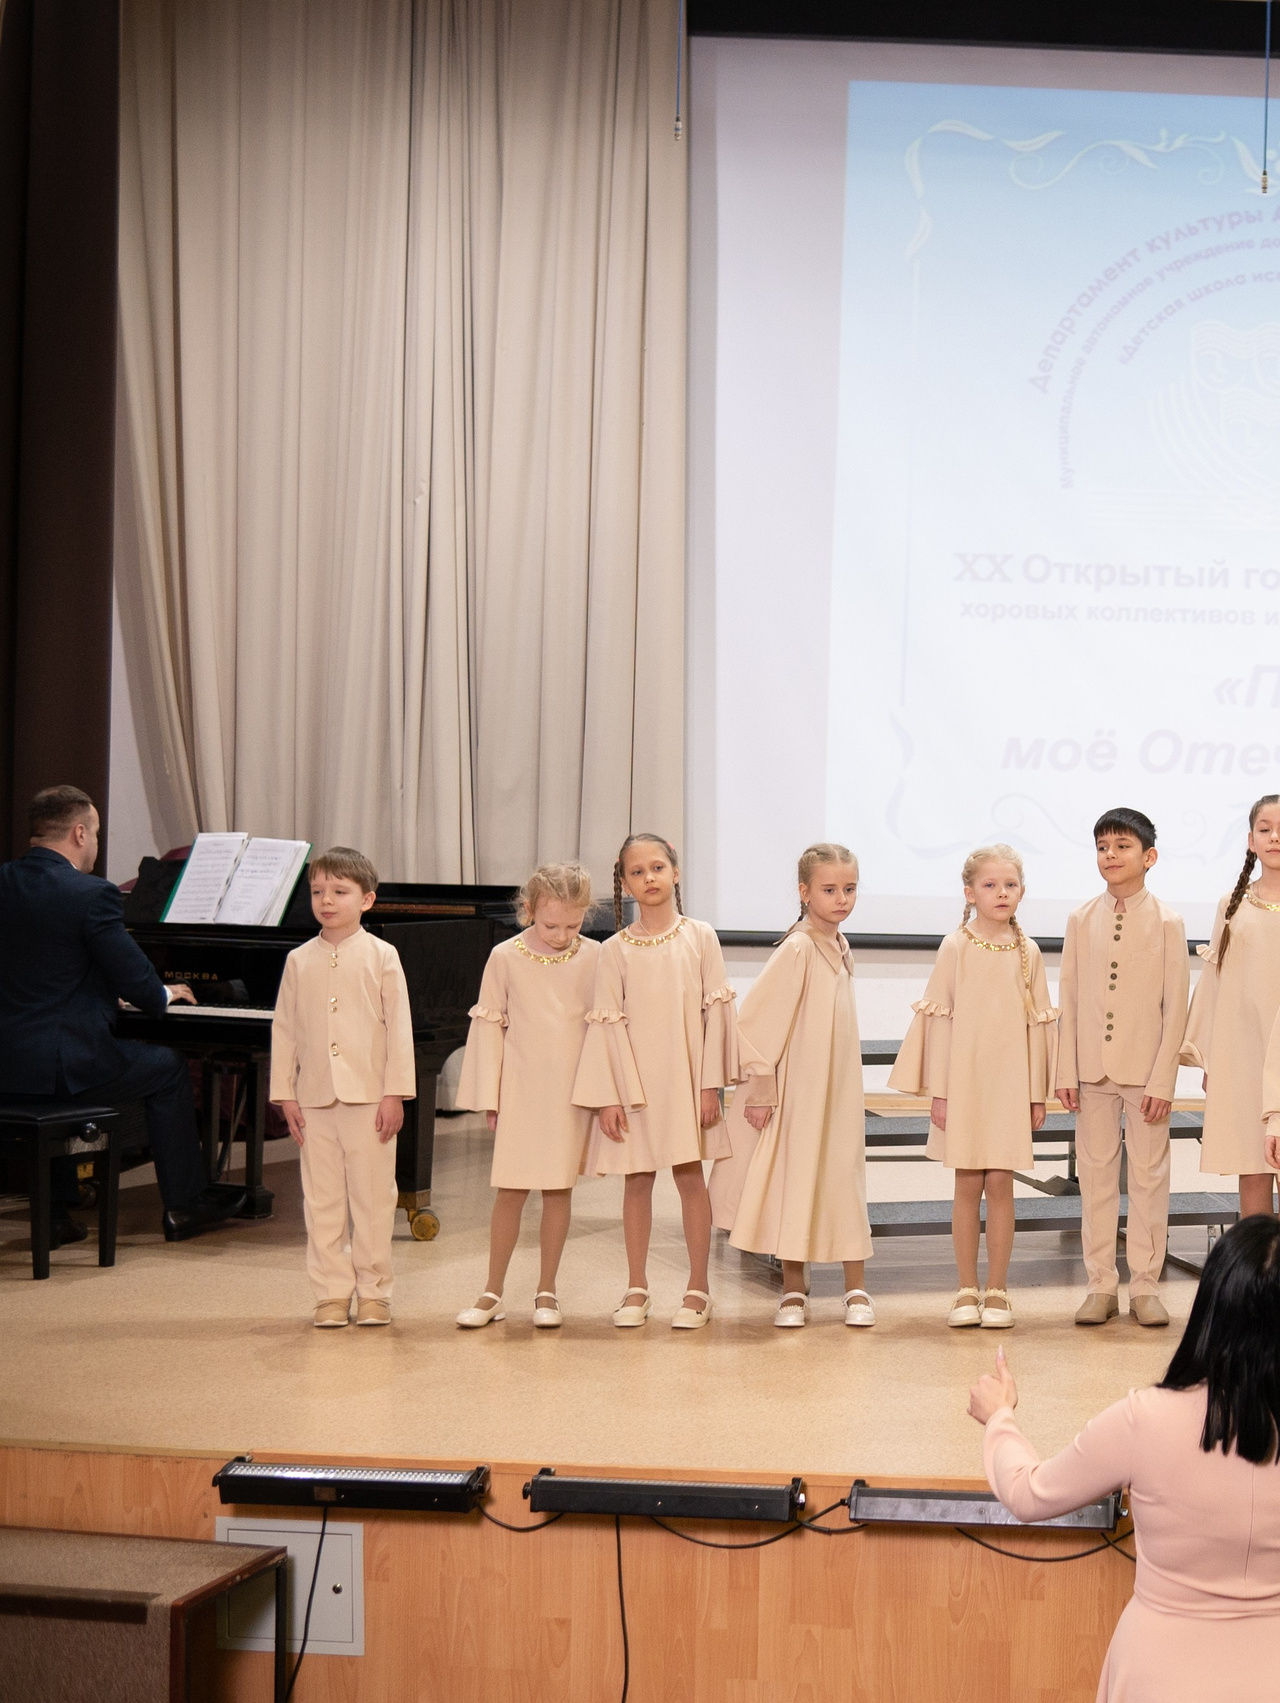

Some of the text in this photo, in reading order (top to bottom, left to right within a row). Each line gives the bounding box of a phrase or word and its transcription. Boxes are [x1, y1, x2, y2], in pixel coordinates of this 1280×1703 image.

[1028, 247, 1141, 394] Департамент
[1145, 209, 1264, 254] культуры
[1117, 297, 1187, 365] «Детская
[1186, 273, 1248, 303] школа
[1058, 356, 1087, 490] Муниципальное
[1081, 276, 1155, 355] автономное
[1154, 238, 1256, 283] учреждение
[1021, 552, 1230, 594] Открытый
[960, 602, 1079, 624] хоровых
[1086, 604, 1255, 626] коллективов
[1264, 610, 1280, 627] и
[1000, 728, 1119, 772] моё
[164, 970, 218, 981] МОСКВА
